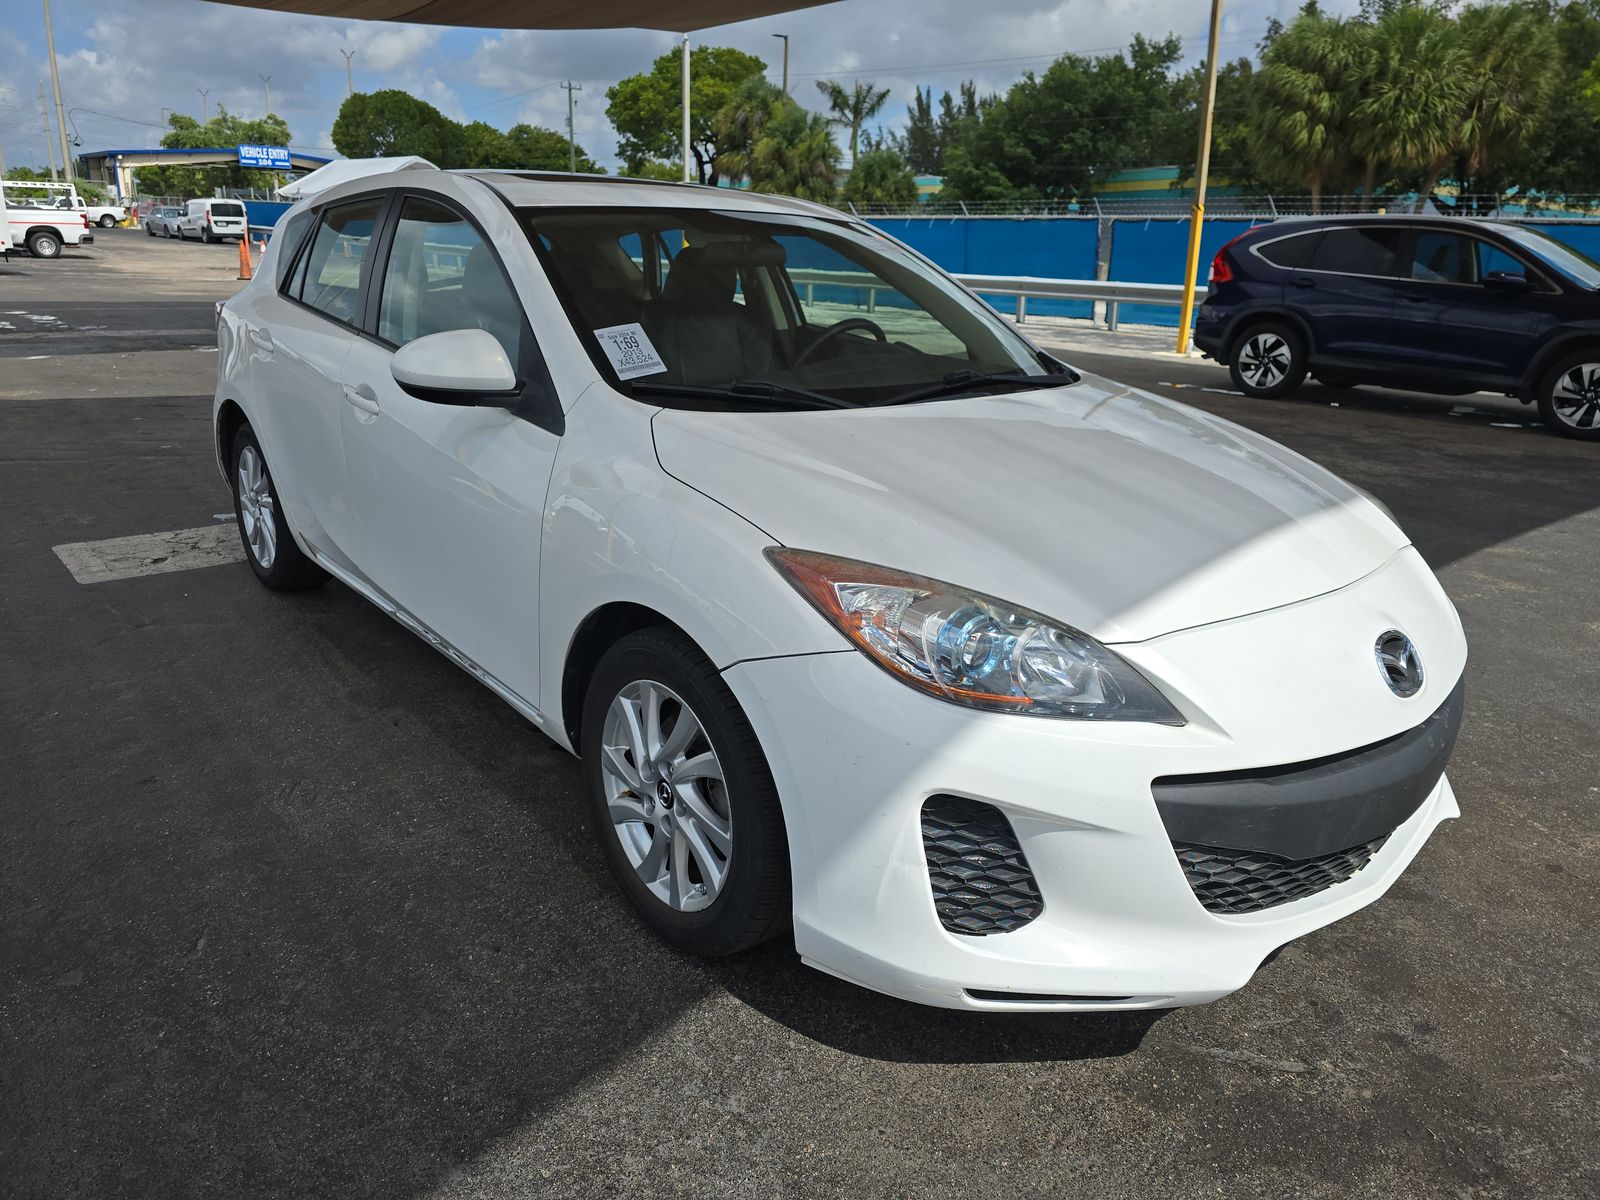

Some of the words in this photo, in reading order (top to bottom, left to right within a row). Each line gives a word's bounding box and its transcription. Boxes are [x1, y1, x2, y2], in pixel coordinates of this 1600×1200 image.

[240, 146, 268, 159] VEHICLE
[268, 148, 288, 161] ENTRY
[613, 336, 640, 351] 1:69
[617, 353, 653, 367] X43,524
[621, 348, 643, 358] 2013
